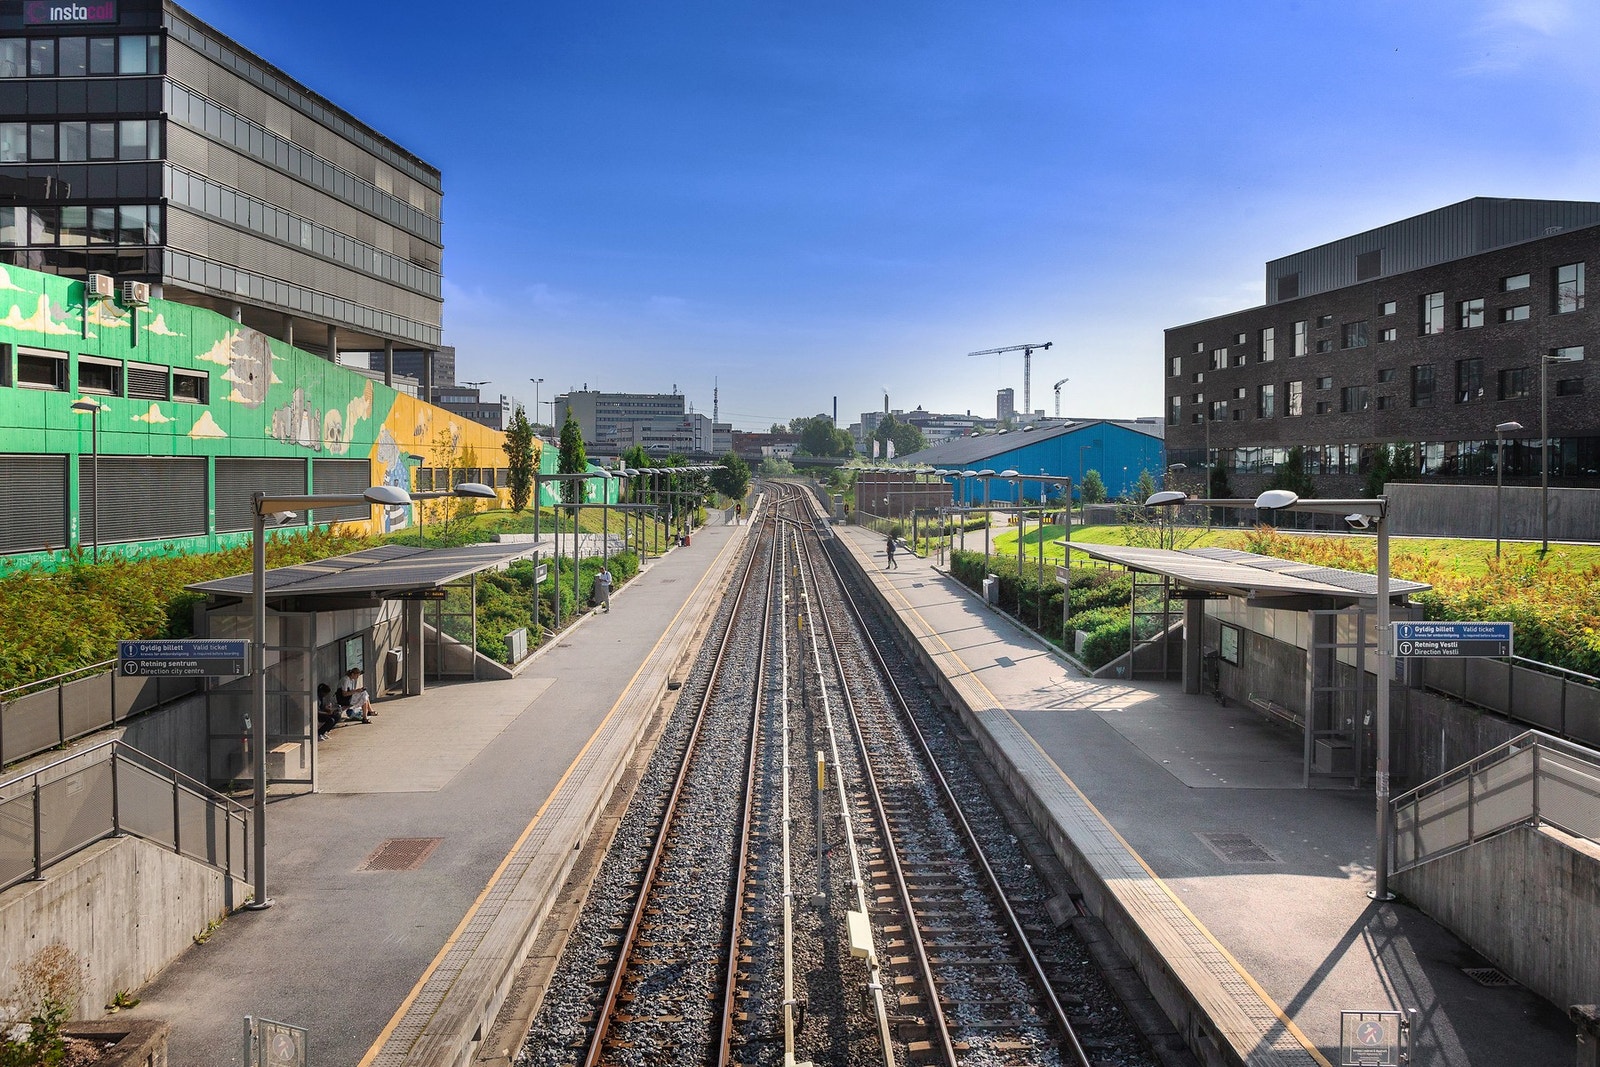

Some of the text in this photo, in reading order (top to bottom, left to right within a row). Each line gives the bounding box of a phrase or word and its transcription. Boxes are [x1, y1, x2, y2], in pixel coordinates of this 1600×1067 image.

[50, 2, 113, 20] instacall
[140, 644, 162, 652] Gyldig
[140, 660, 167, 668] Retning
